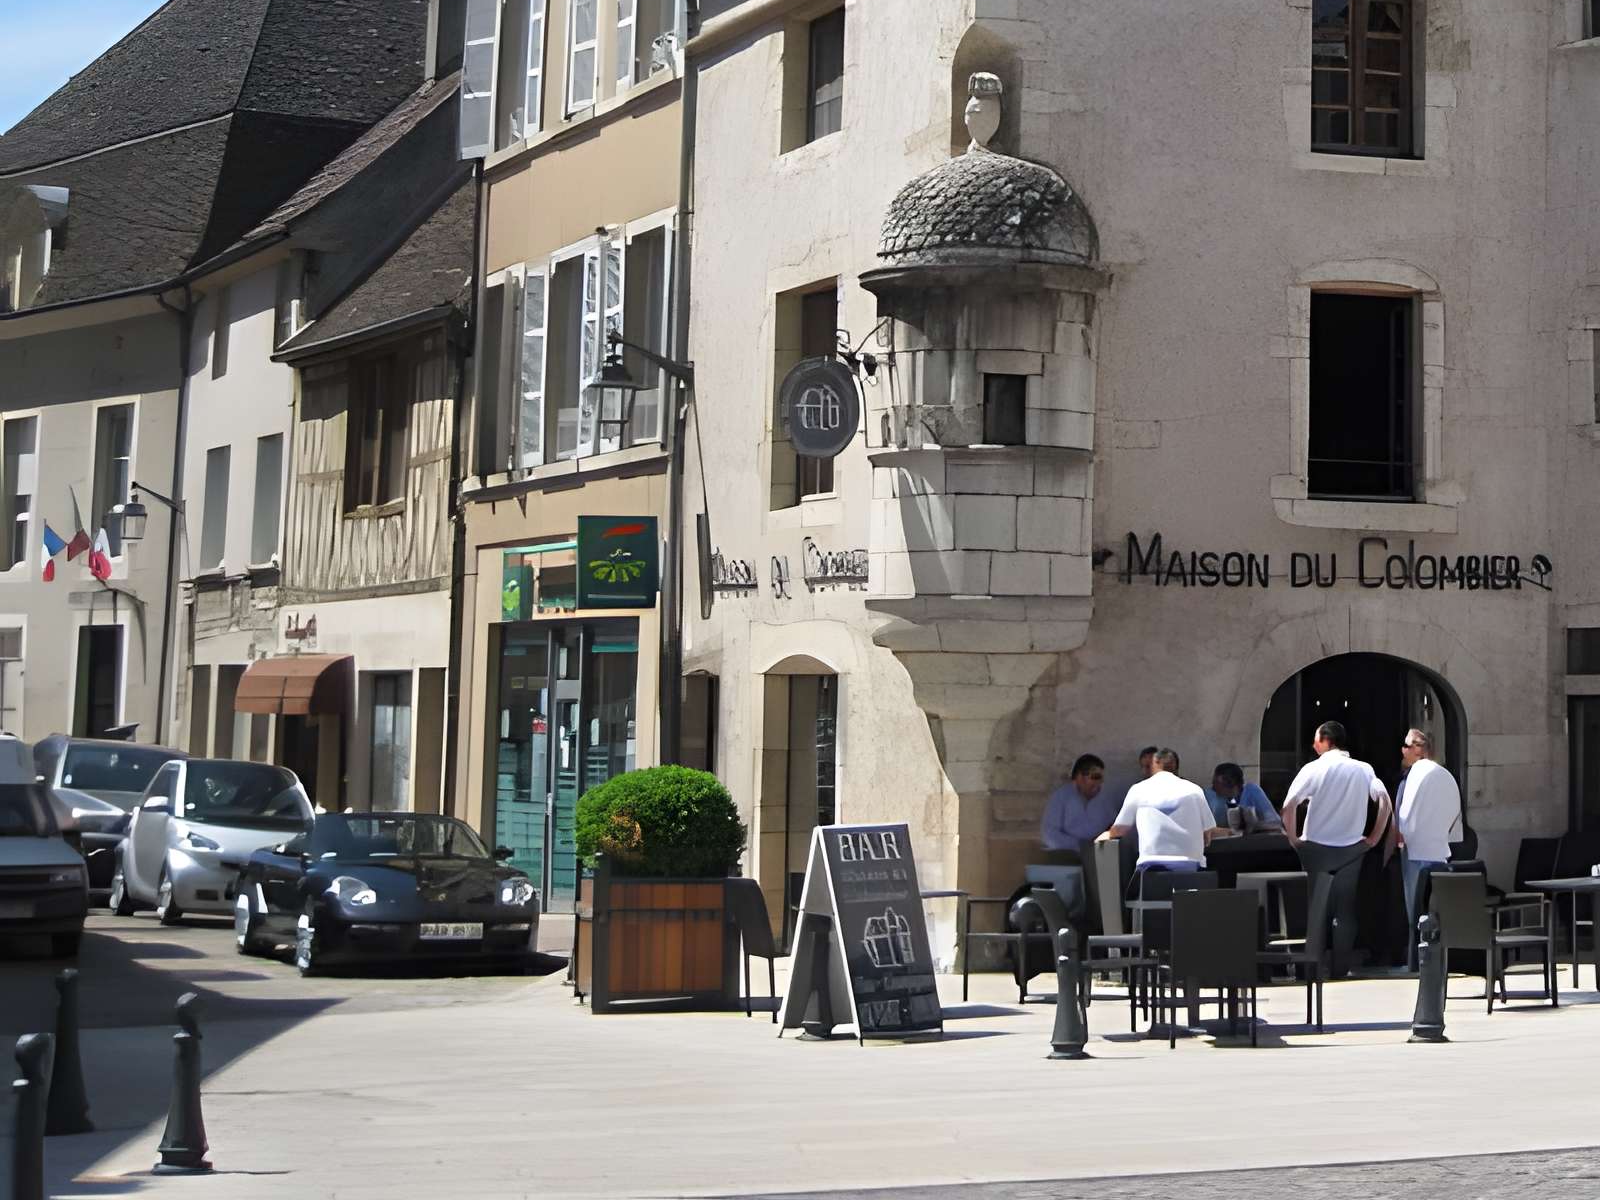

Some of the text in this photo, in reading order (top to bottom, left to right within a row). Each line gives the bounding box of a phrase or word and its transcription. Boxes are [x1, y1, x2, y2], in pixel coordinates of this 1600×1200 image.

[1126, 531, 1270, 588] MAISON
[1290, 551, 1337, 589] DU
[837, 831, 902, 862] BAR
